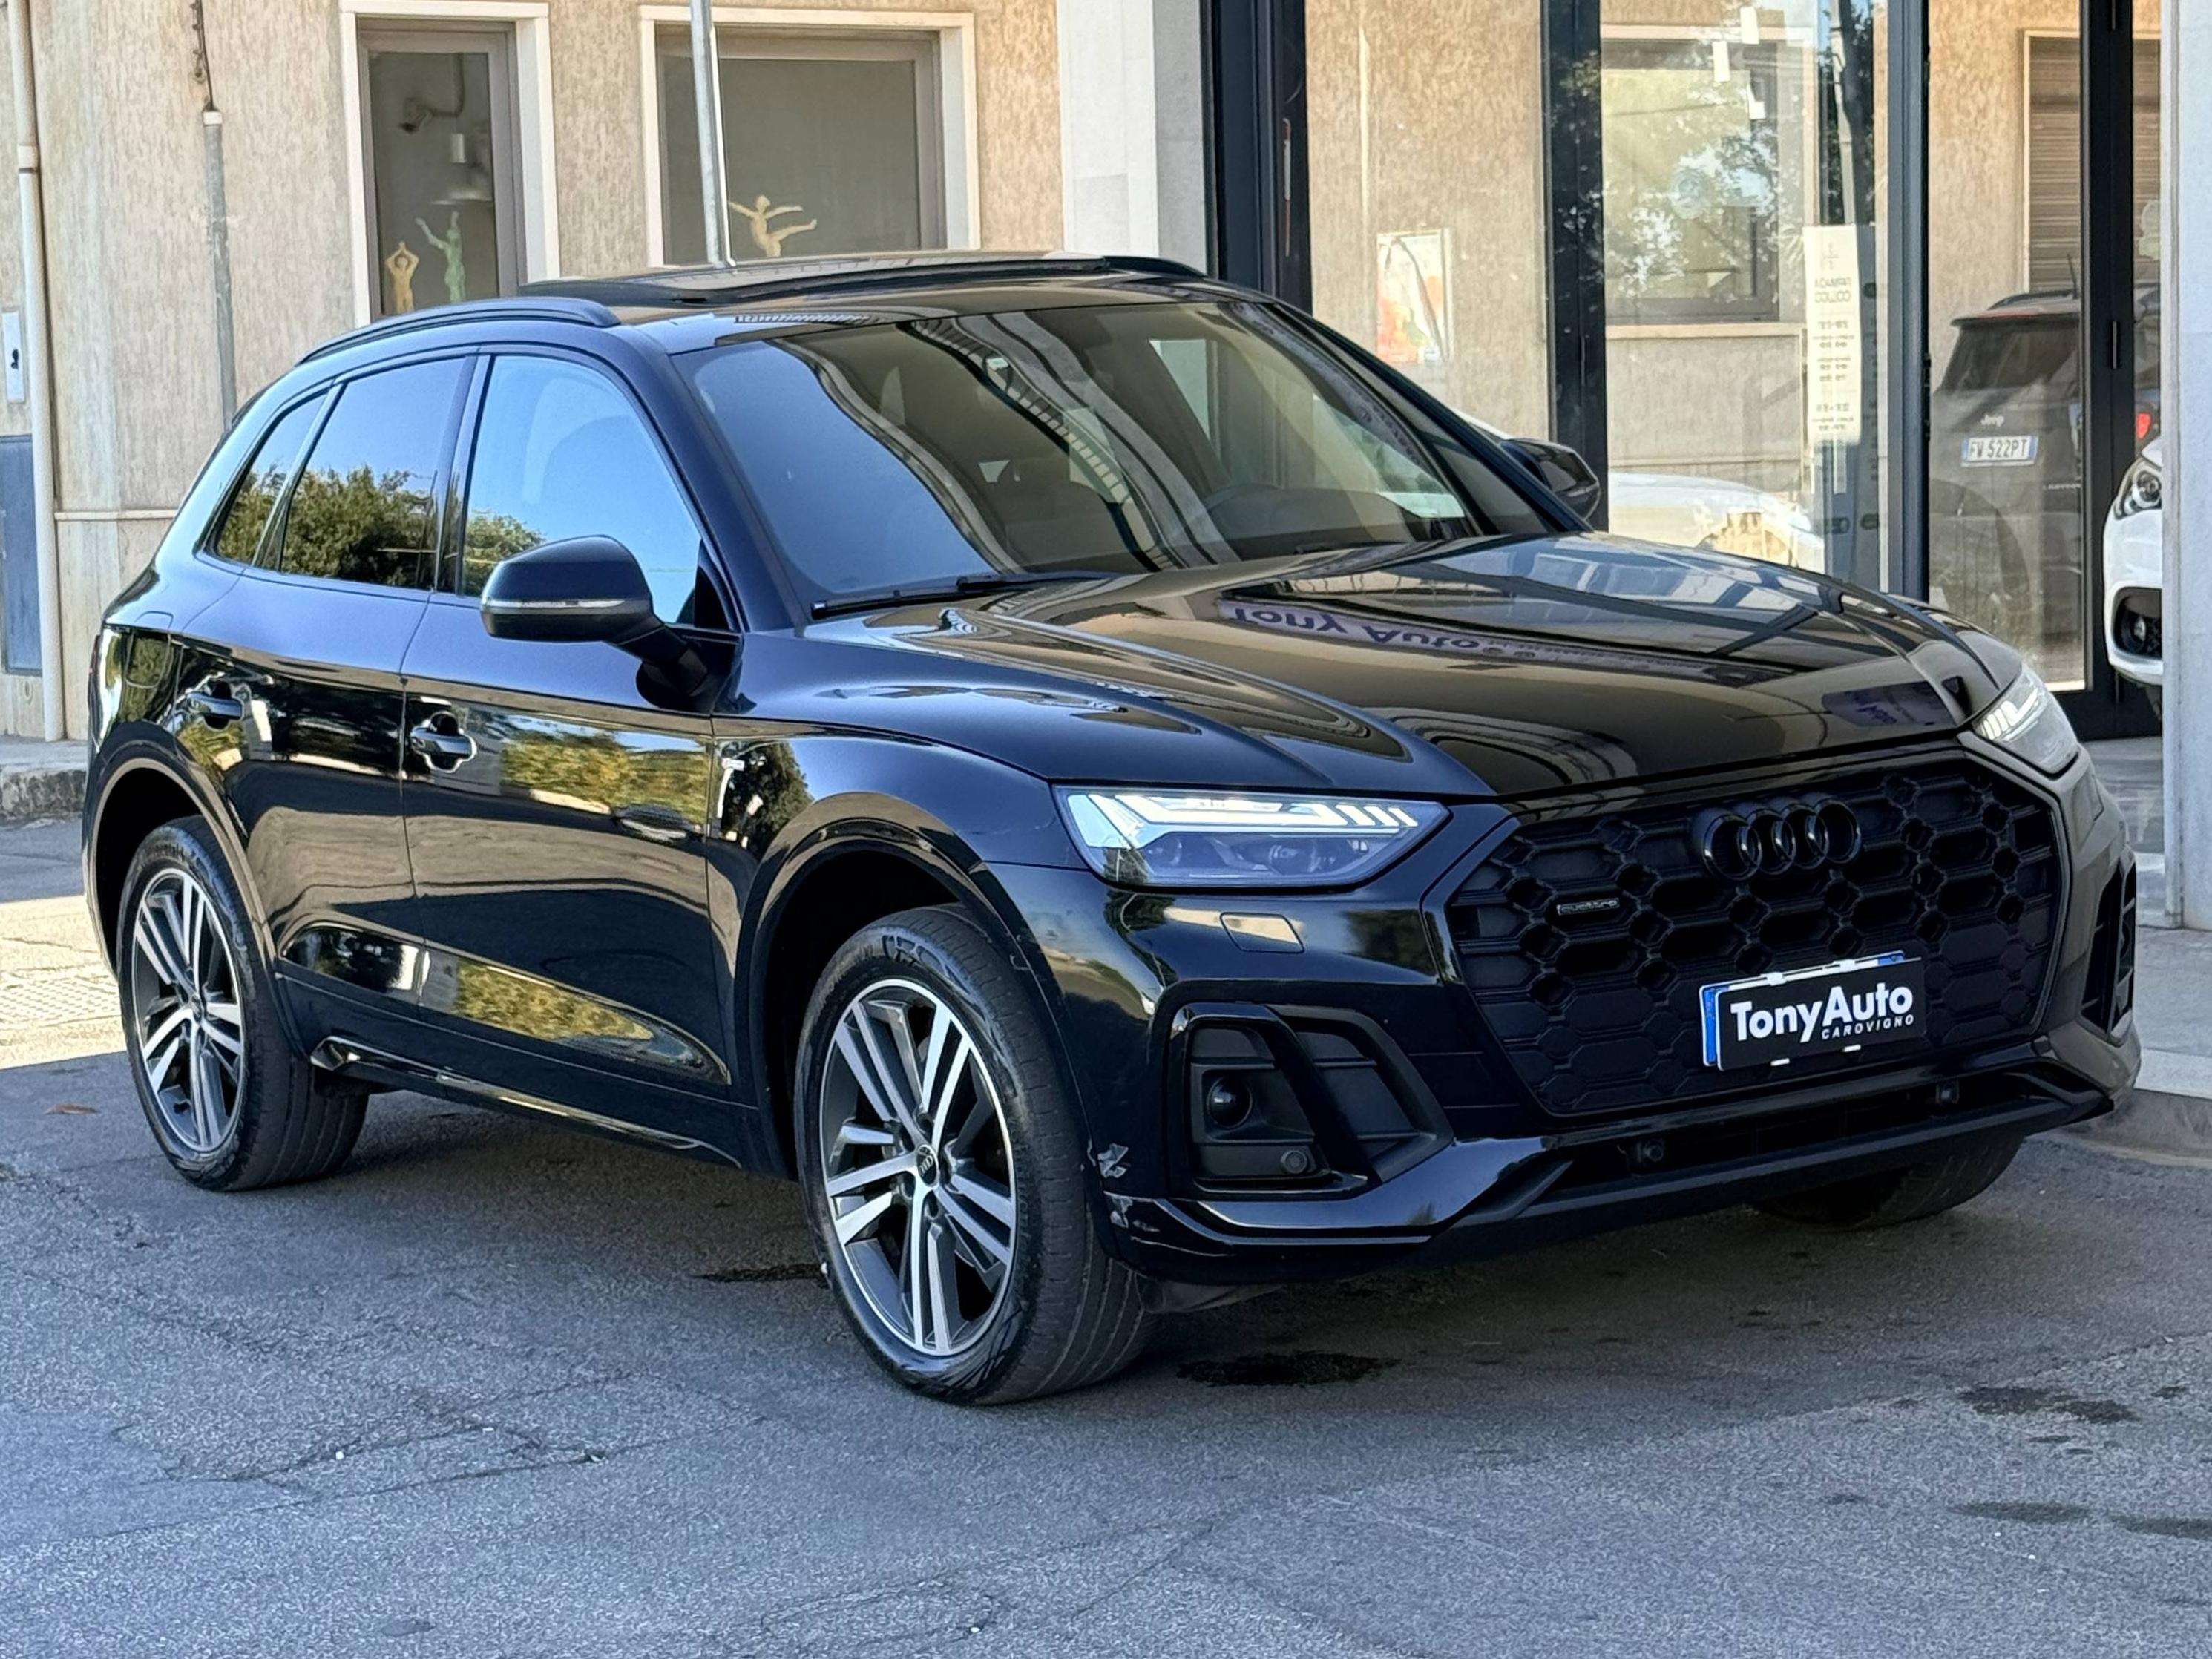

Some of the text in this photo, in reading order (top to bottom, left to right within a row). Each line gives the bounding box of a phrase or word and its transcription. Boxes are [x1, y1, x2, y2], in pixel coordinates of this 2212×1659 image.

[1988, 438, 2028, 458] 522PT
[1730, 982, 1914, 1043] TonyAuto
[1821, 1014, 1914, 1040] CAROVIGNO
